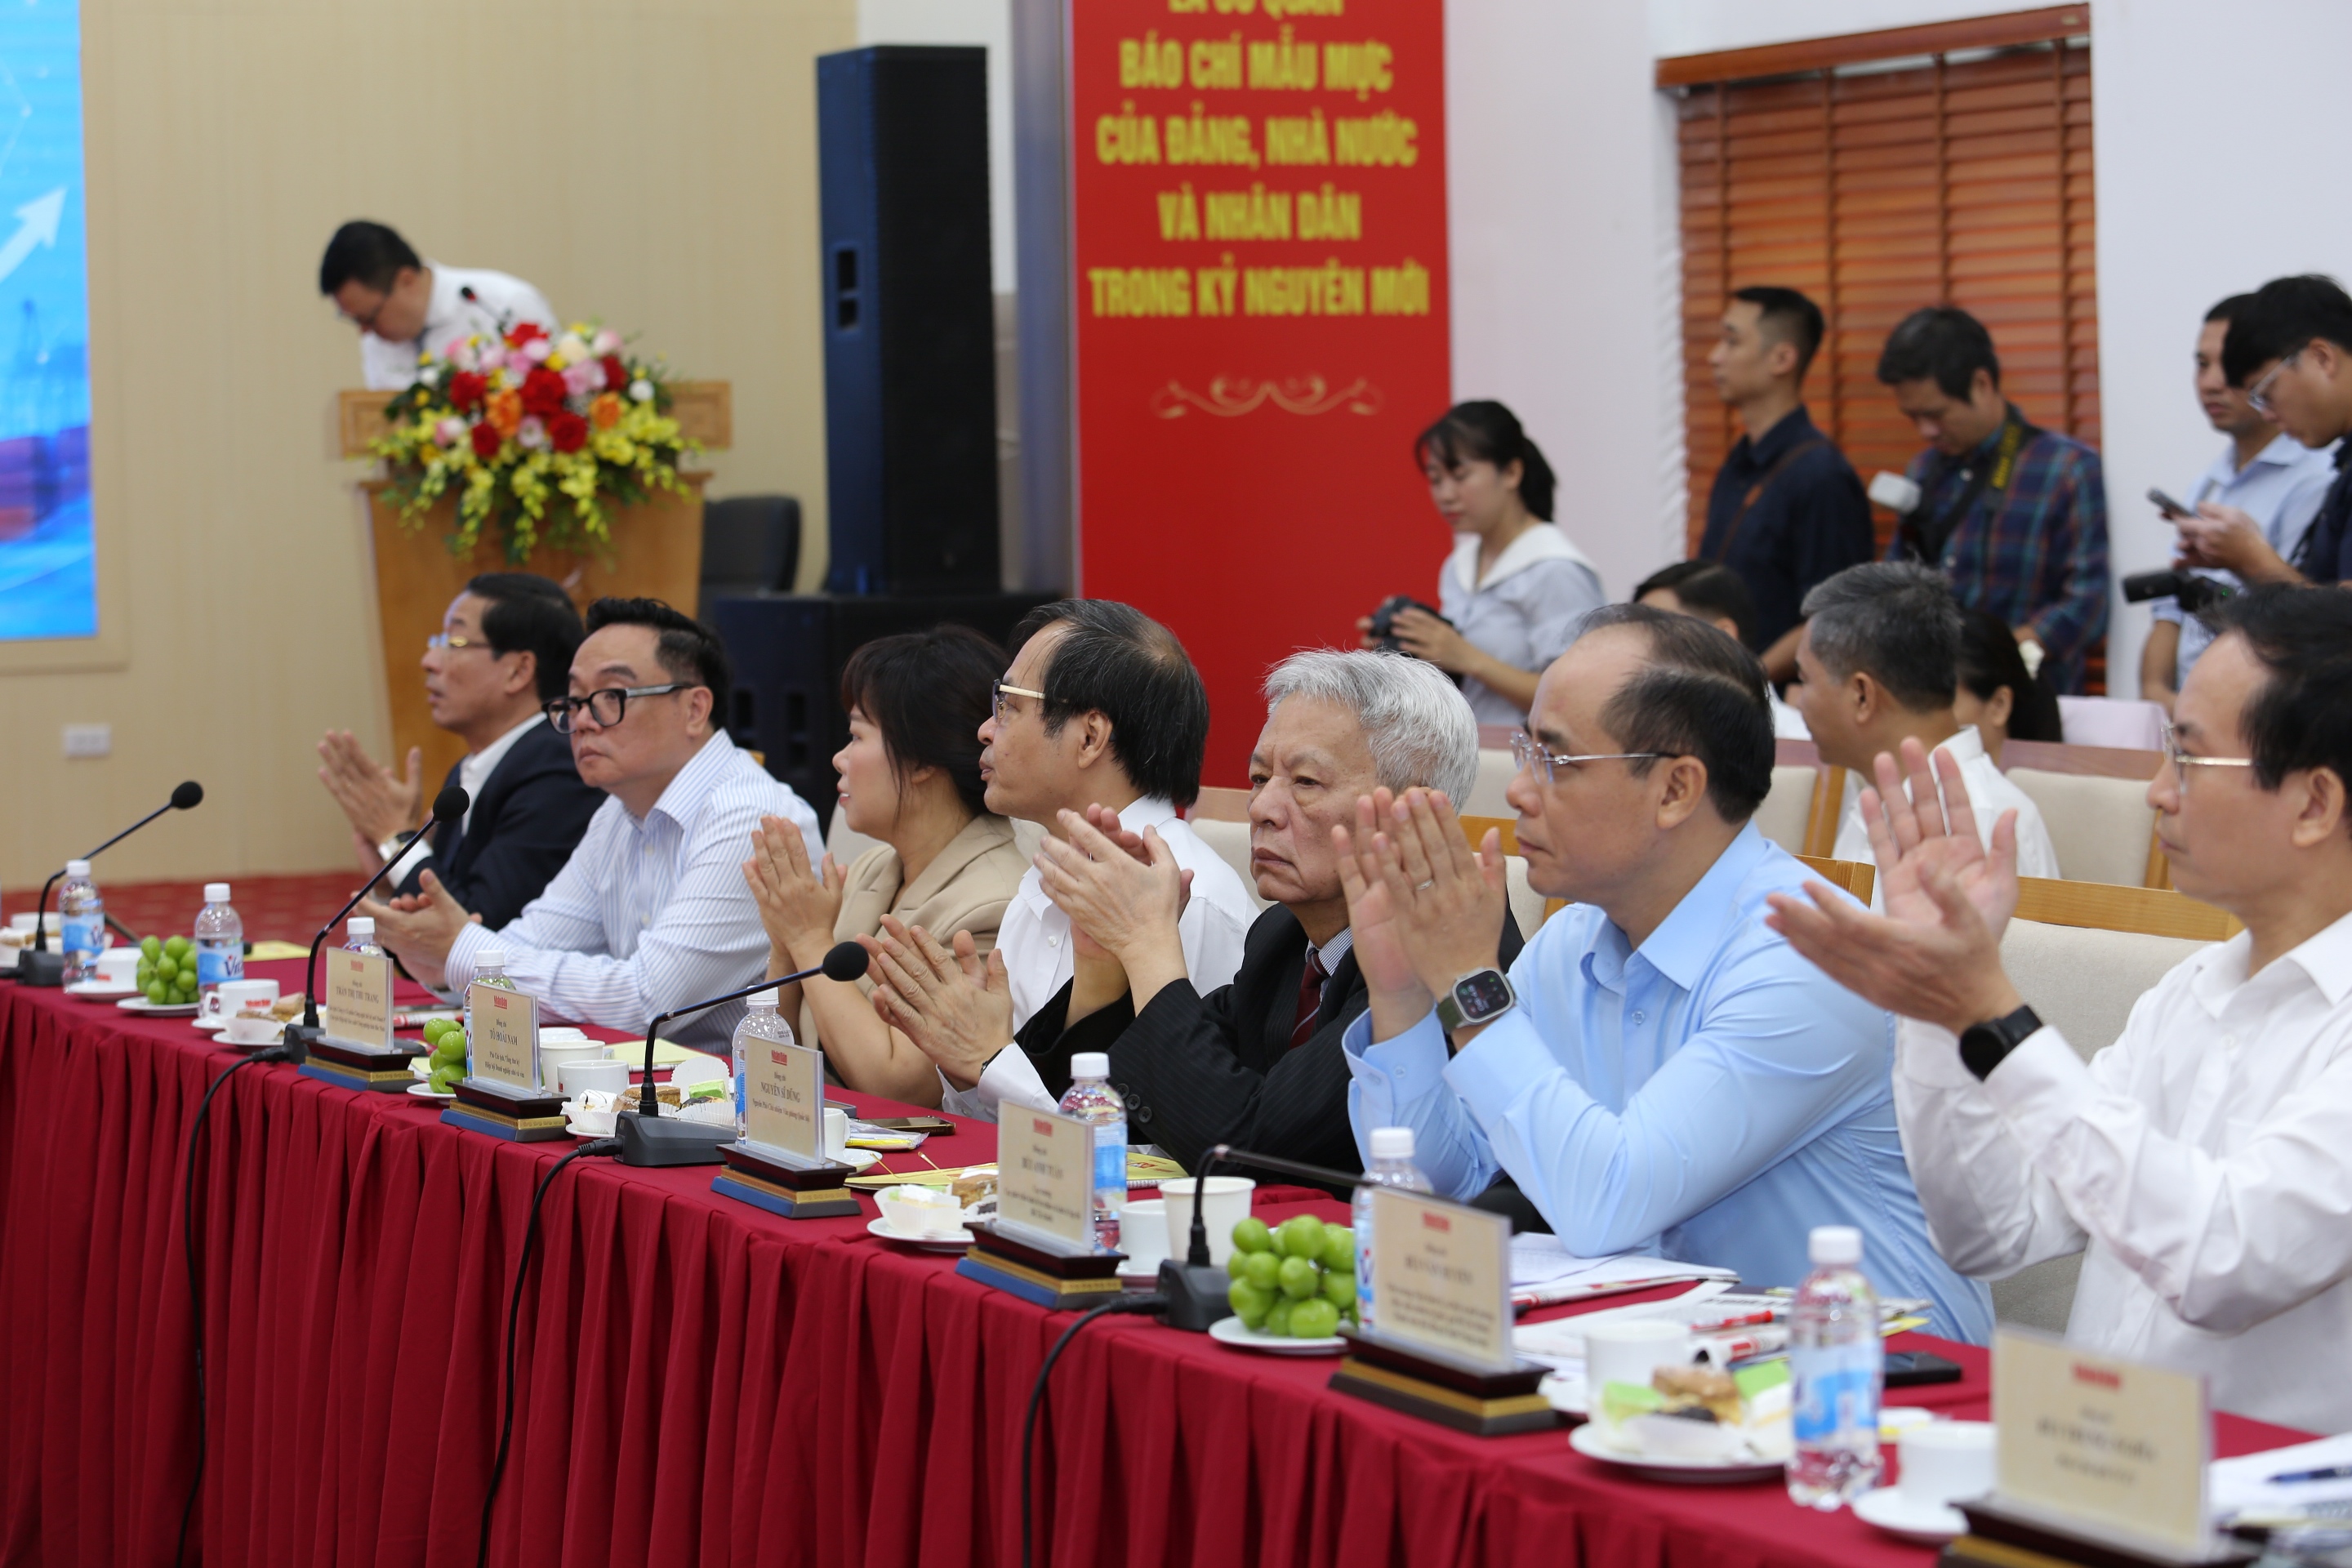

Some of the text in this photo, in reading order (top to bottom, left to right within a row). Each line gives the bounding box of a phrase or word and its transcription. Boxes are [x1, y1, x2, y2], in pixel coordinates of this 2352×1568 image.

[1120, 24, 1392, 100] BÁO CHÍ MẪU MỰC
[1096, 100, 1418, 169] CỦA ĐẢNG, NHÀ NƯỚC
[1158, 182, 1361, 240] VÀ NHÂN DÂN
[1089, 252, 1429, 316] TRONG KỶ NGUYÊN MỚI
[507, 1034, 518, 1046] NAM
